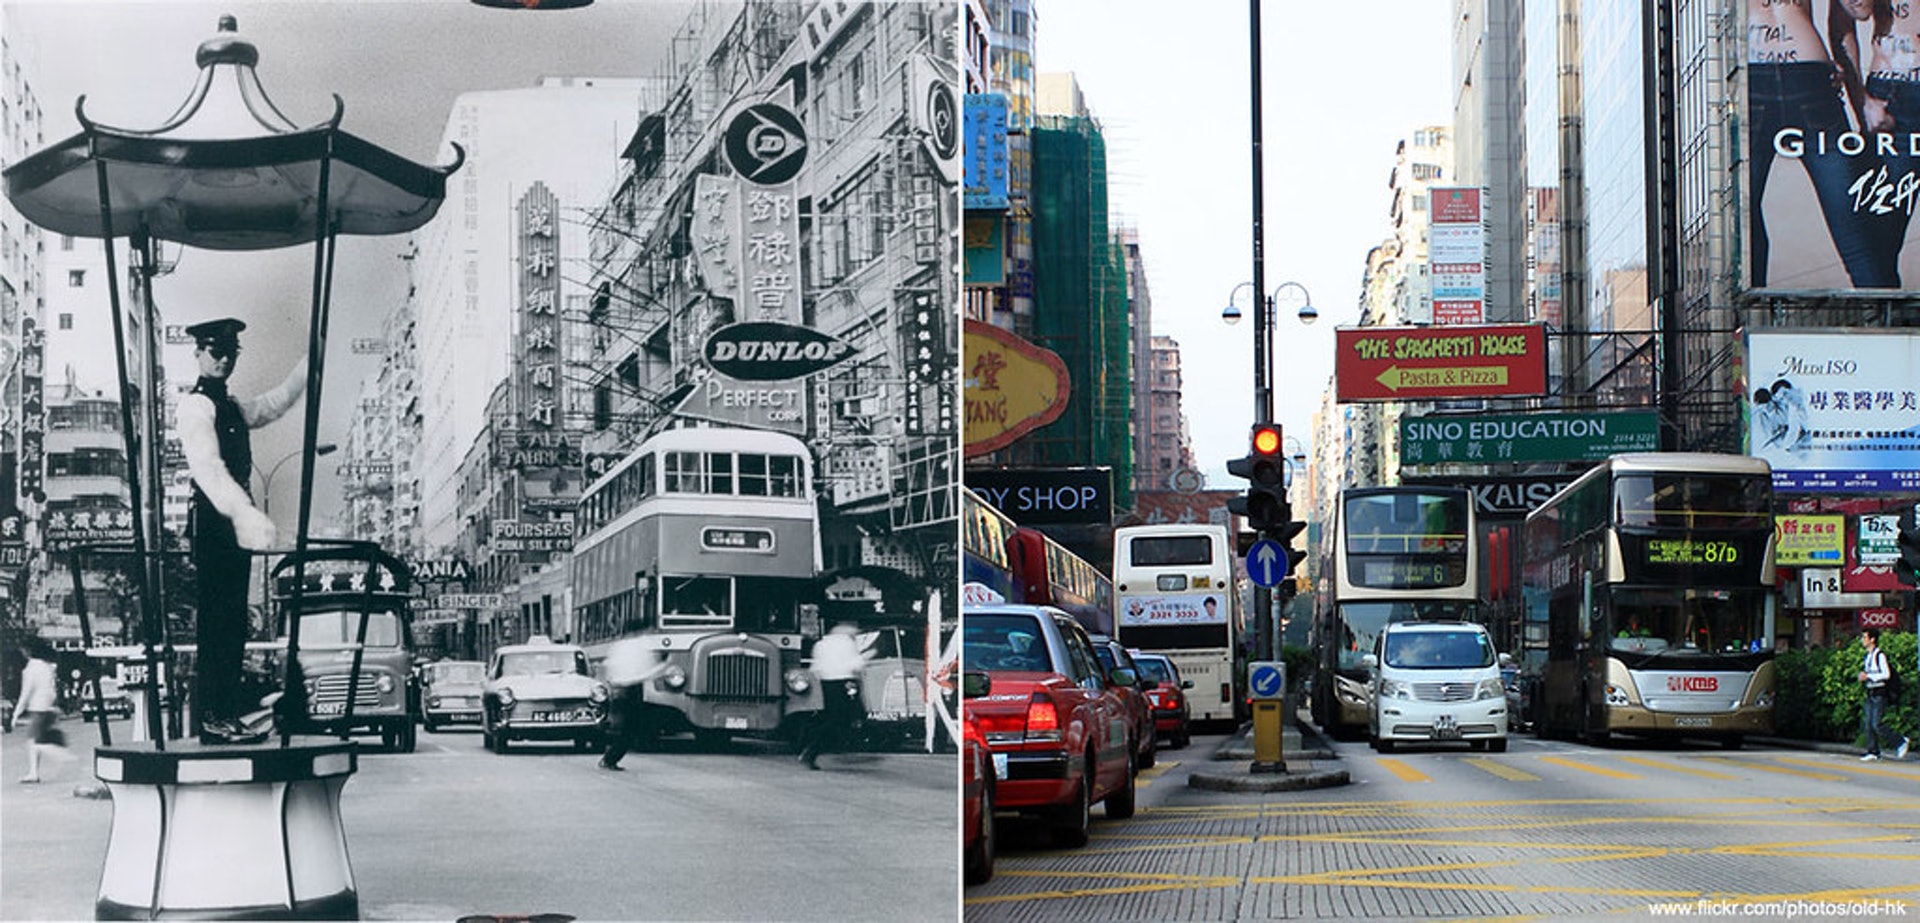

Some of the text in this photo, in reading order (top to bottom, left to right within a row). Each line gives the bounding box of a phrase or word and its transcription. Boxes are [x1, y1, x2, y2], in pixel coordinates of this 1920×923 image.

[746, 190, 796, 321] 鄧祿普
[711, 340, 851, 362] DUNLOP
[1354, 334, 1527, 359] THE SPAGHETTI HOUSE
[1400, 366, 1498, 386] Pasta & Pizza
[705, 381, 799, 408] PERFECT
[1407, 419, 1606, 441] SINO EDUCATION
[1018, 486, 1098, 511] SHOP
[495, 522, 572, 538] FOURSEAS
[1705, 542, 1737, 562] 87D
[1807, 577, 1839, 592] In &
[441, 595, 499, 608] SINGER
[1683, 677, 1719, 691] KMB
